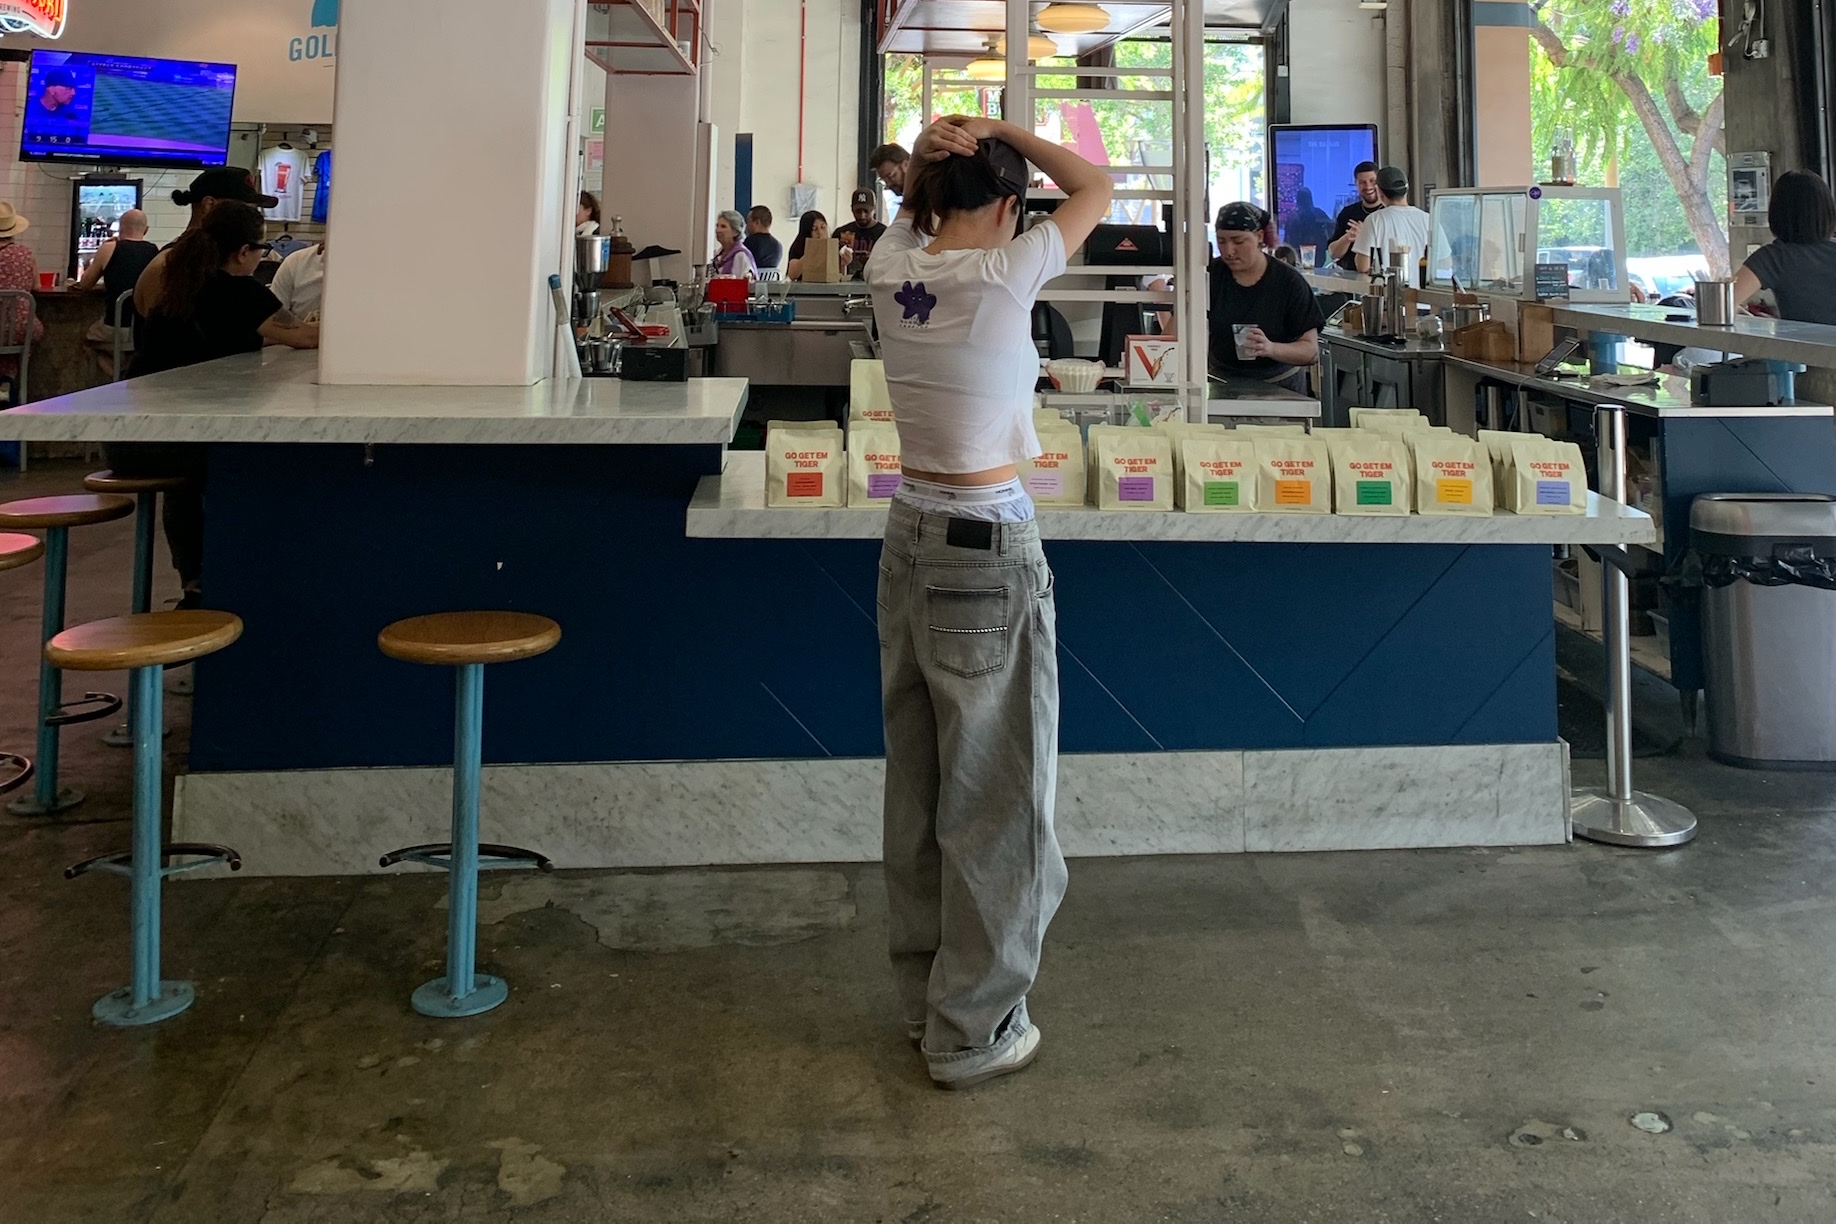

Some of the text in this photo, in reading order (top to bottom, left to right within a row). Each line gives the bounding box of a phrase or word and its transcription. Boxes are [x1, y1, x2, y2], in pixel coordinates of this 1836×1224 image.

[289, 34, 333, 61] GOL
[1033, 460, 1059, 468] TIGER
[1362, 462, 1379, 470] GET
[1380, 462, 1392, 470] EM
[1444, 461, 1461, 469] GET
[1280, 468, 1304, 476] TIGER
[1360, 470, 1384, 478] TIGER
